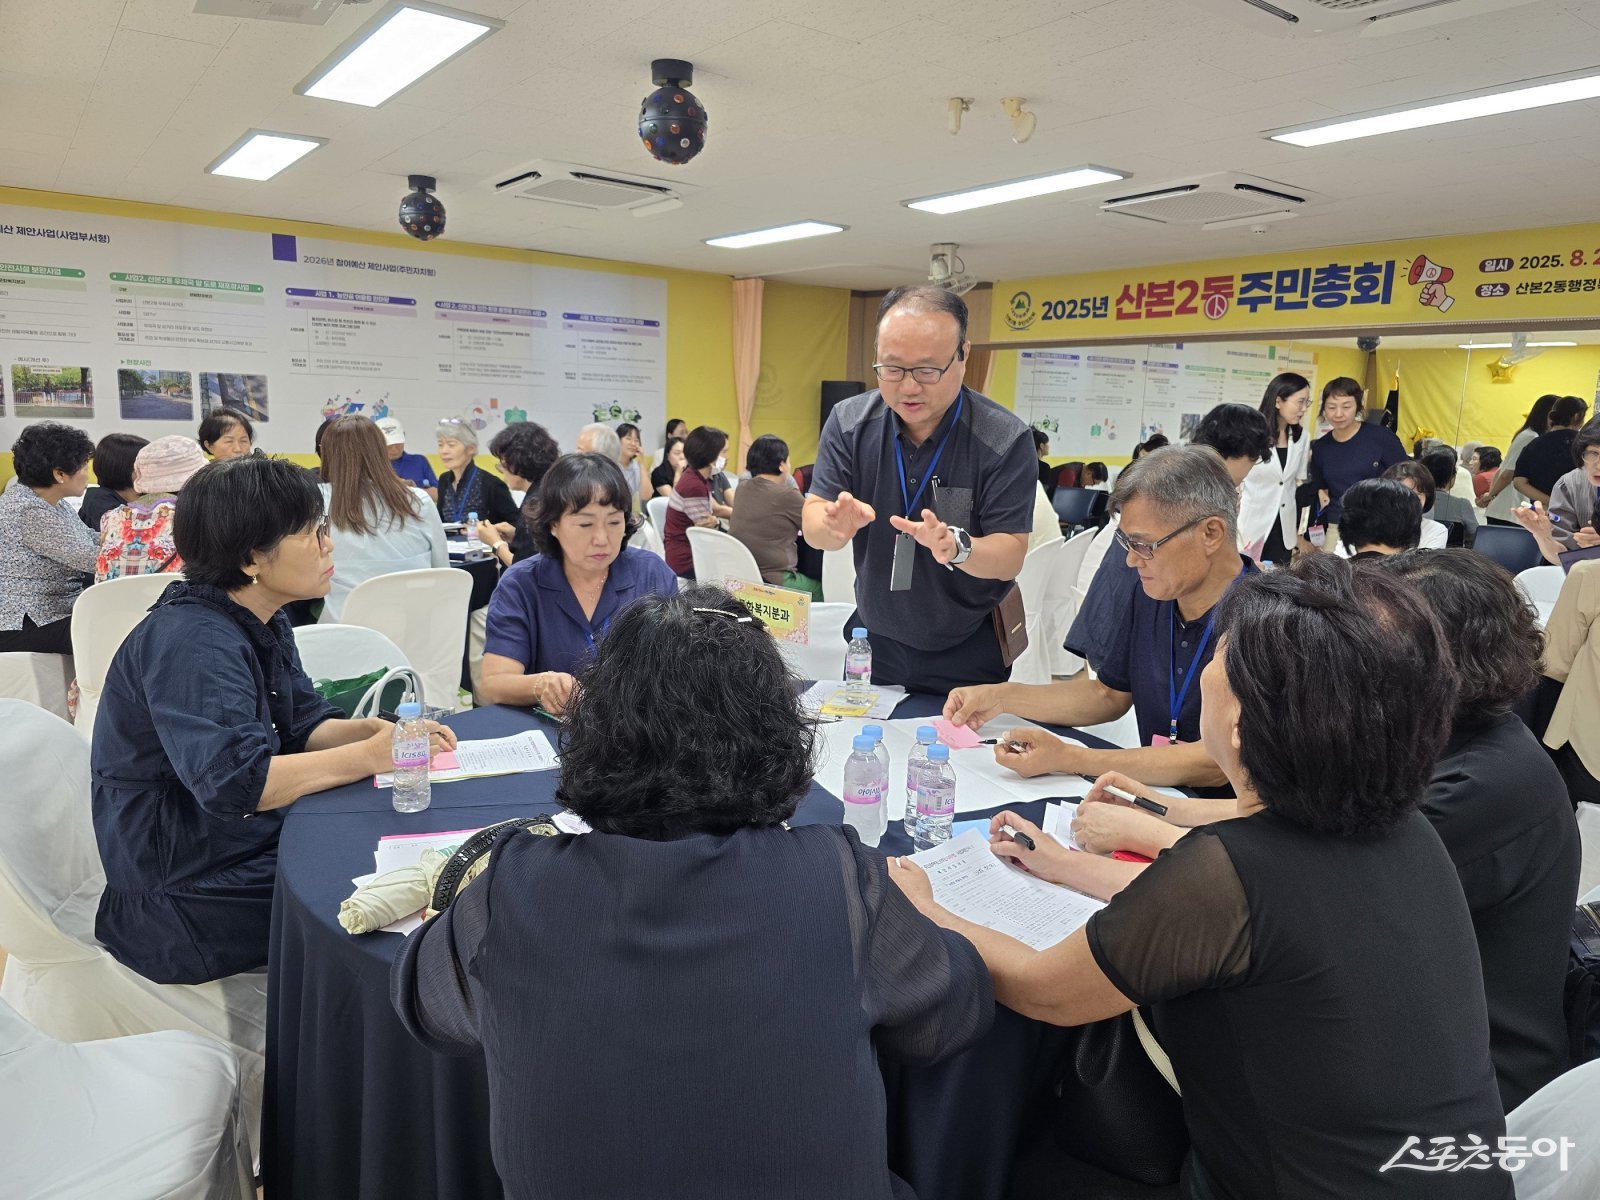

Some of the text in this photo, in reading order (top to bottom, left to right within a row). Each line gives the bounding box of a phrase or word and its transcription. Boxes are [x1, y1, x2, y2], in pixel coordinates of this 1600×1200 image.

[16, 226, 110, 244] 제안사업(사업부서형)
[303, 255, 335, 266] 2026년
[1484, 259, 1509, 272] 일시
[1519, 254, 1564, 270] 2025.
[1569, 249, 1587, 267] 8.
[1041, 260, 1396, 321] 2025년 산본2동 주민총회
[1480, 279, 1600, 297] 장소 산본2동행정
[745, 599, 790, 623] 화복지분과
